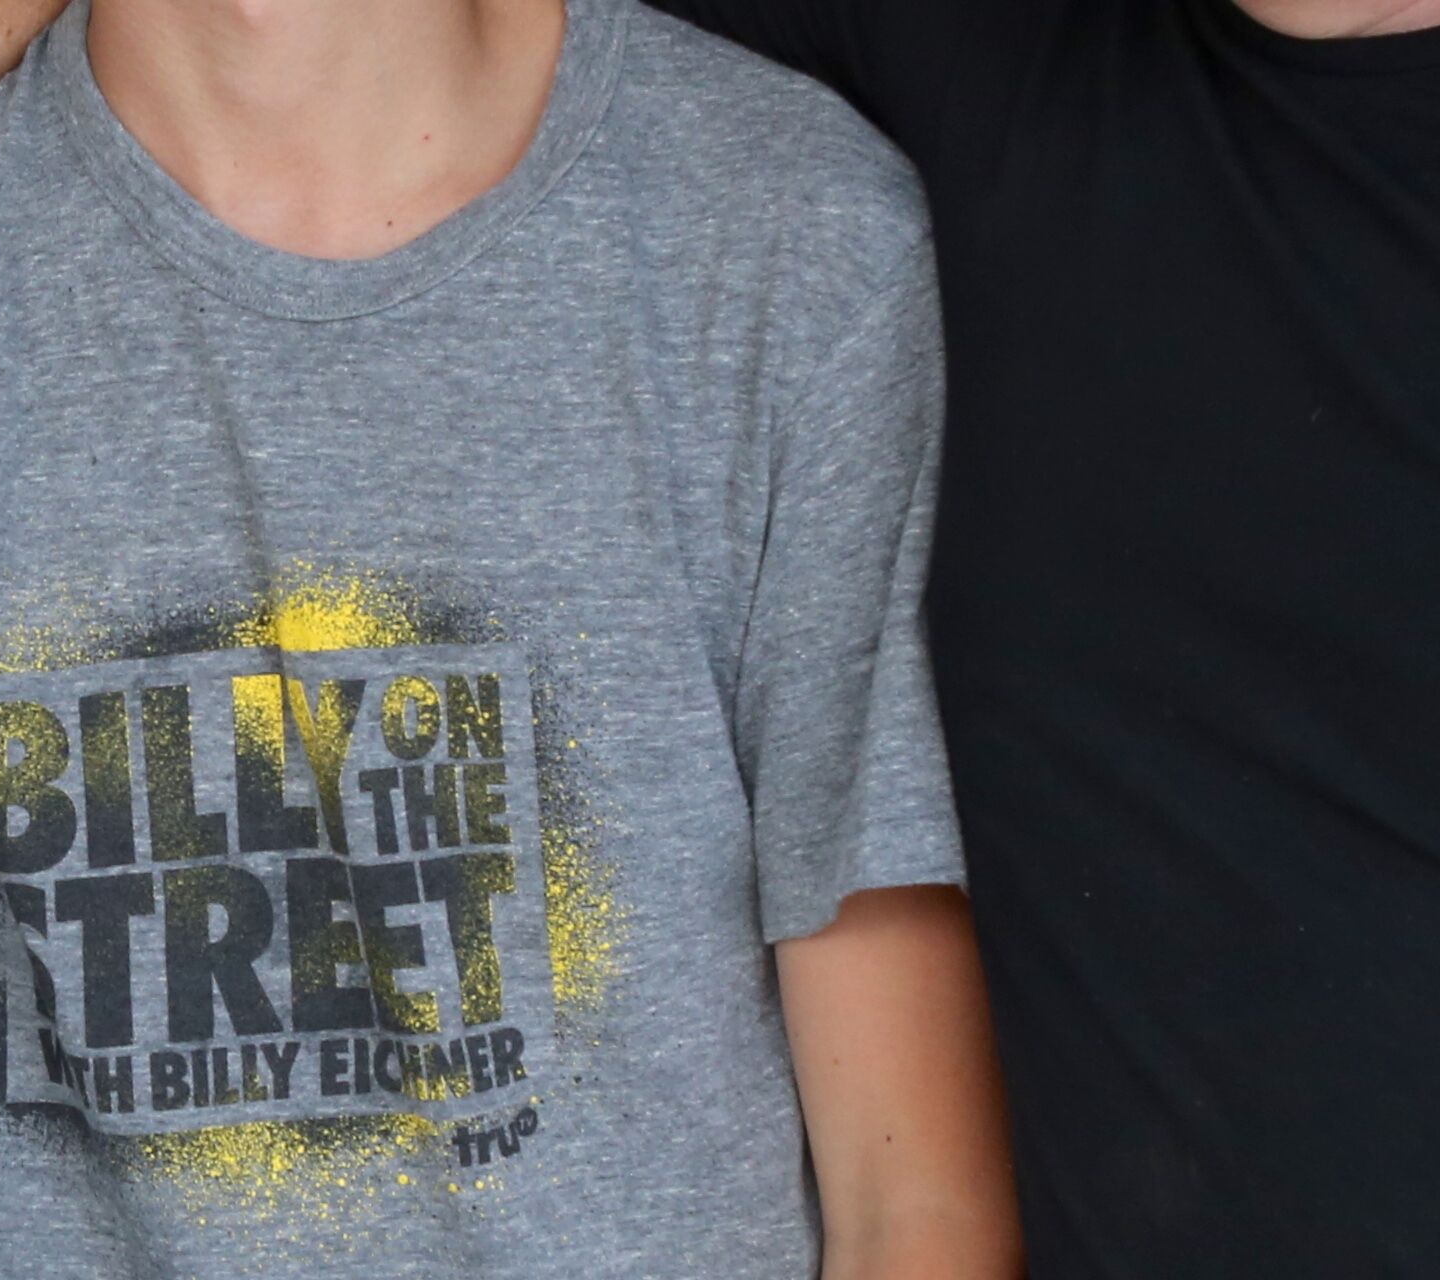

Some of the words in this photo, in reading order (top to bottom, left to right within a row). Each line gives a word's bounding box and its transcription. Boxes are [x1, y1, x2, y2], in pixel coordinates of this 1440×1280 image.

[380, 672, 505, 761] ON
[358, 762, 512, 856] THE
[150, 1041, 301, 1111] BILLY
[321, 1027, 528, 1101] EICHNER
